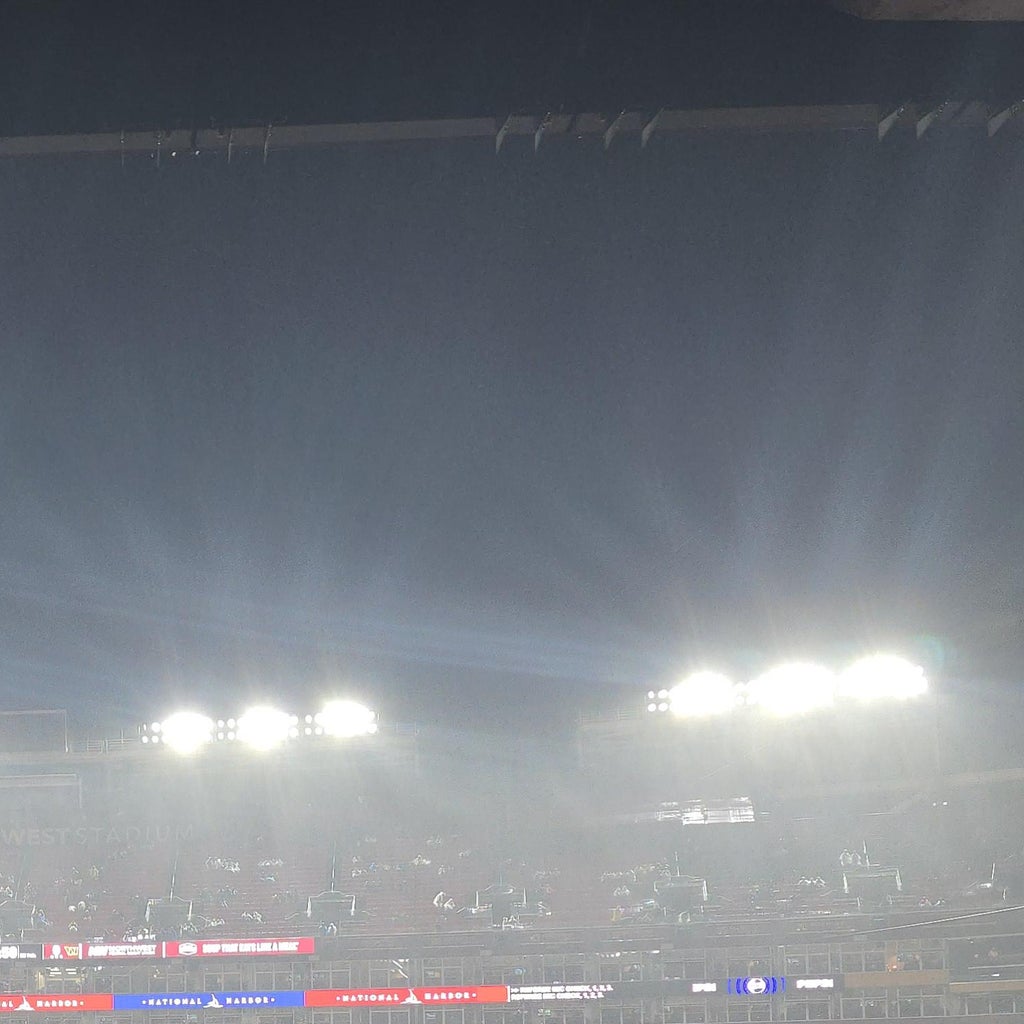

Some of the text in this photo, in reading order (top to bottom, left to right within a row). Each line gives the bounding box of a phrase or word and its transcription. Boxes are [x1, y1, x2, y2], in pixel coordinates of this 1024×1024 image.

[343, 992, 470, 1001] NATIONAL HARBOR
[149, 997, 269, 1005] NATIONAL HARBOR
